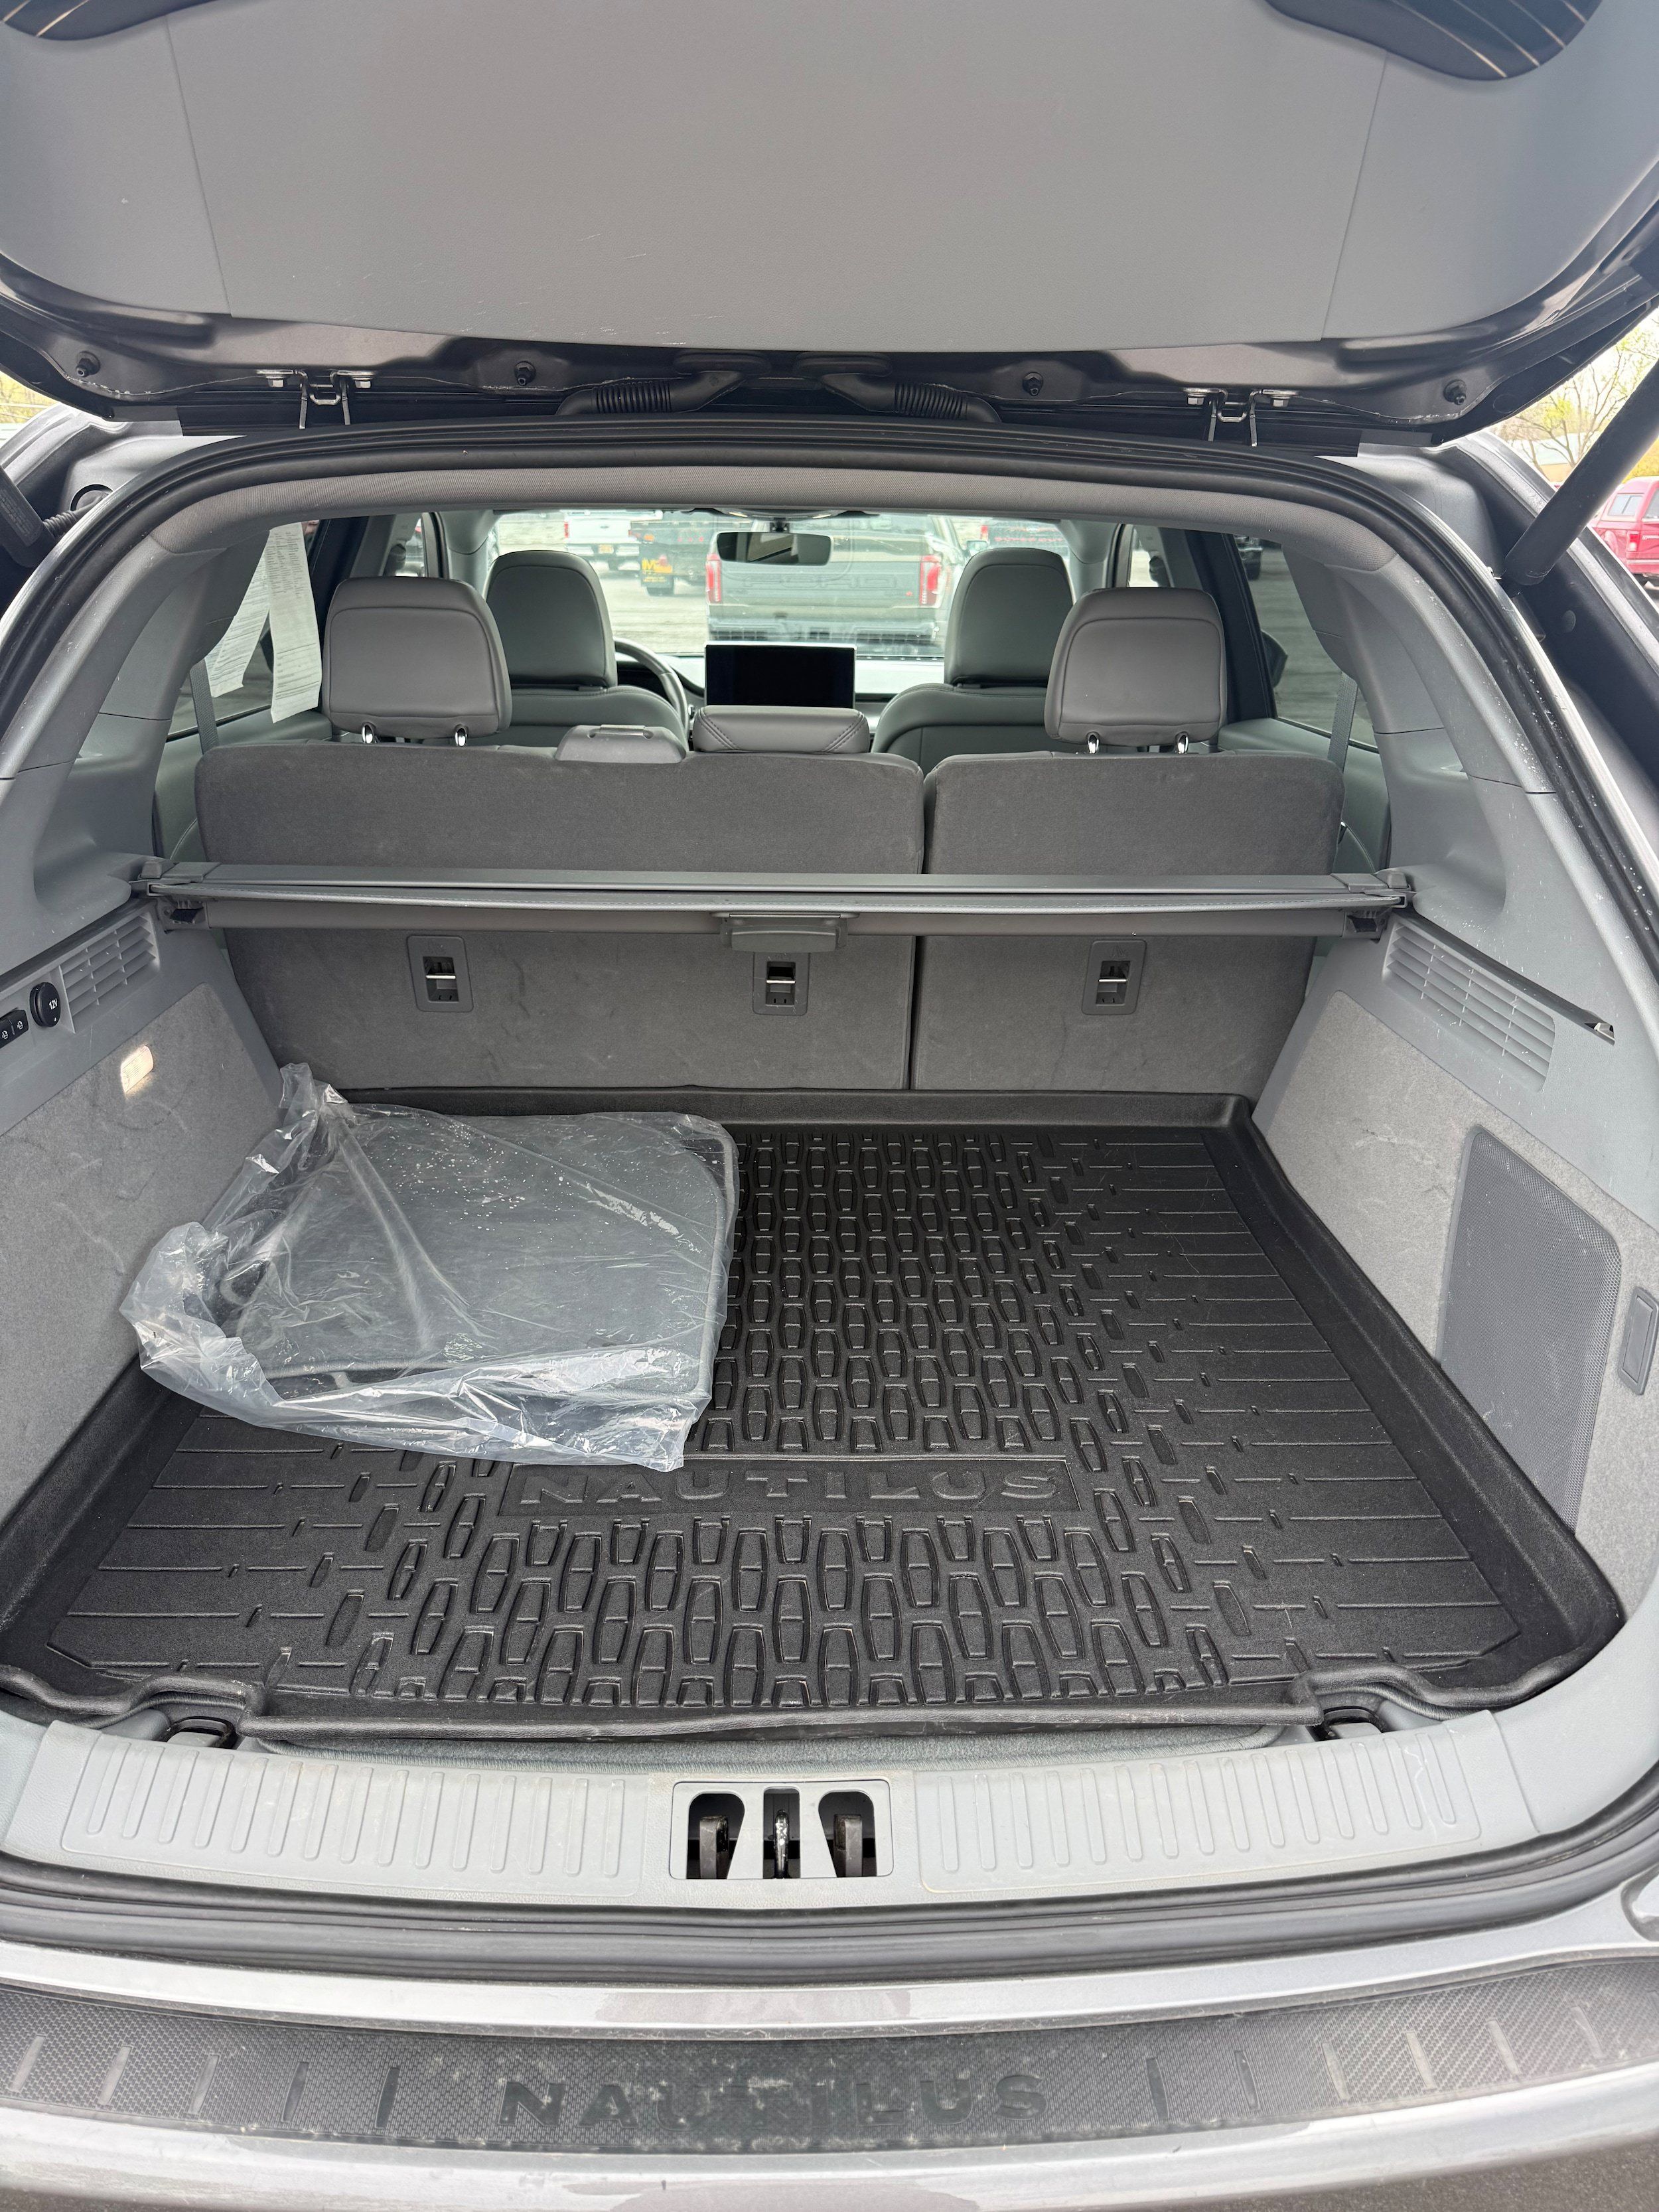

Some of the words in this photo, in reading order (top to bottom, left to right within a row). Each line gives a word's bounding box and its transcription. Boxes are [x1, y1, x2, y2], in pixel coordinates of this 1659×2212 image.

[48, 997, 58, 1010] 12V
[519, 1469, 1057, 1505] NAUTILUS
[498, 2073, 1048, 2132] NAUTILUS
